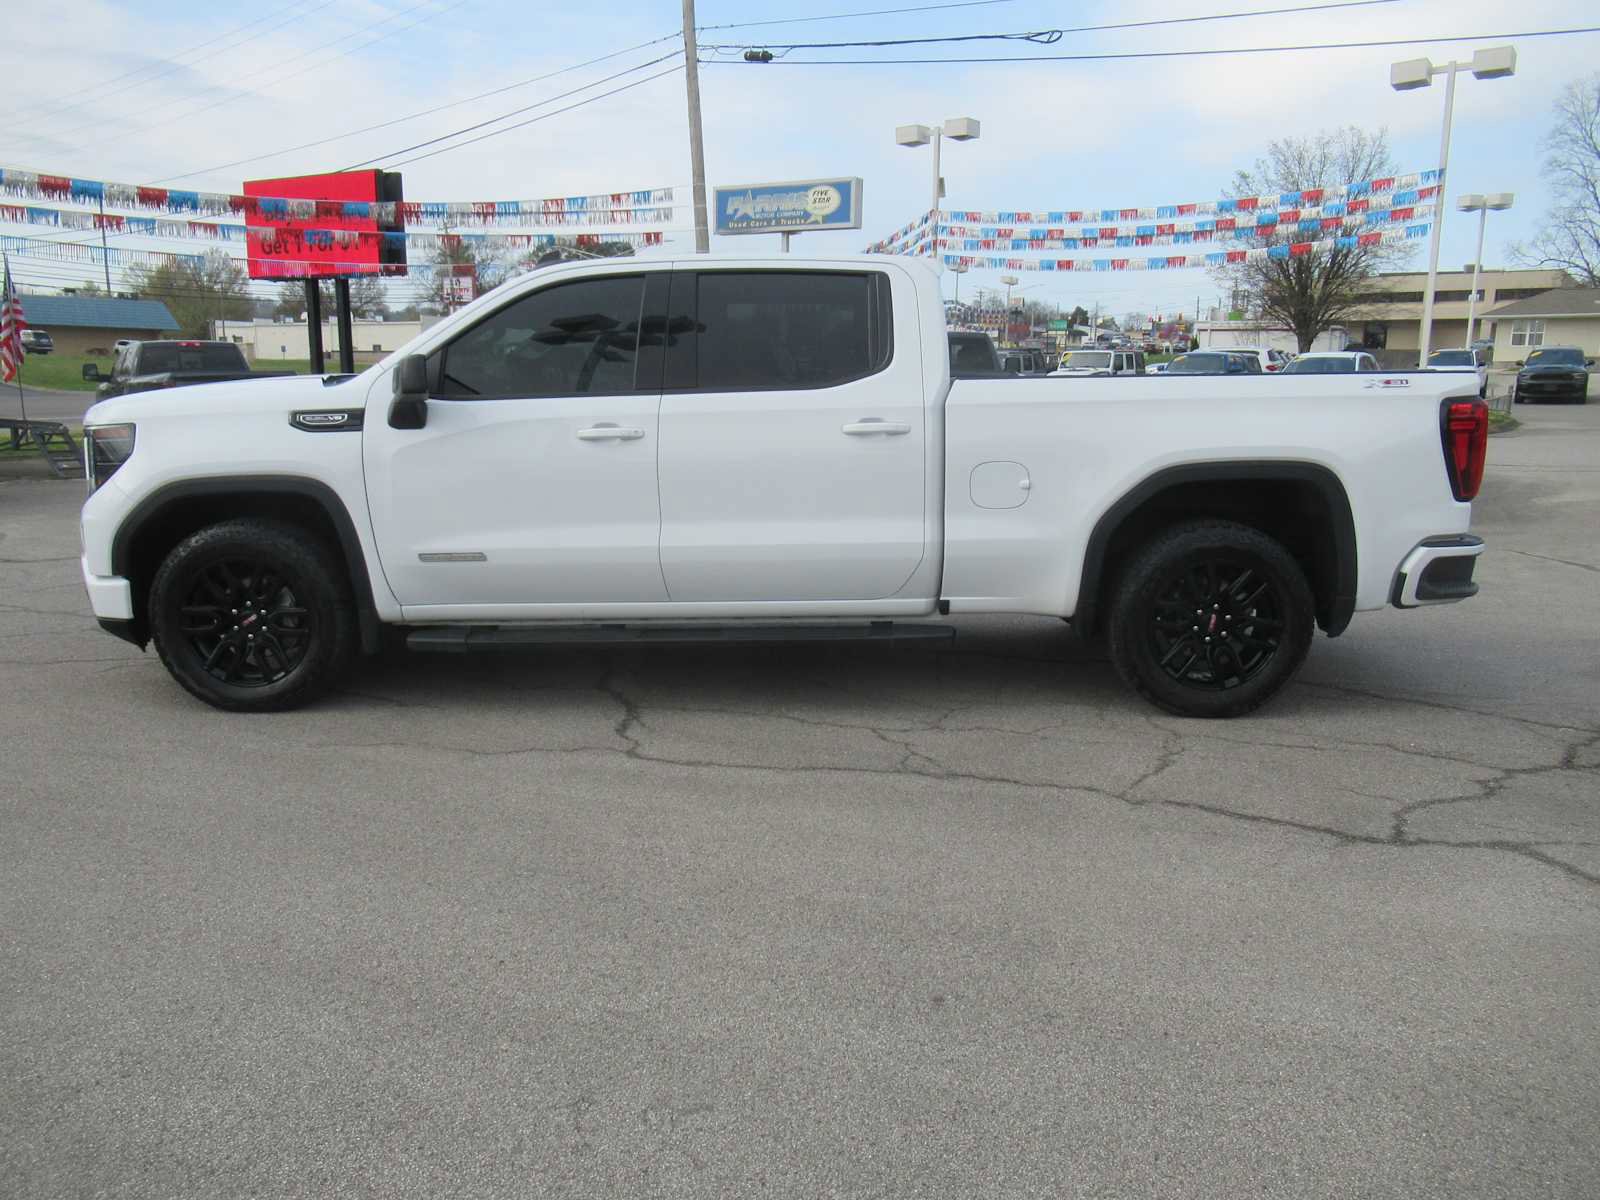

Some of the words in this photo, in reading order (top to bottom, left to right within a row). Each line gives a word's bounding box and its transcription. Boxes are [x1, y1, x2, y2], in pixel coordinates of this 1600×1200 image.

[812, 189, 830, 198] FIVE
[812, 196, 832, 205] STAR
[728, 221, 747, 229] Used
[750, 219, 767, 228] Cars
[780, 218, 805, 226] Trucks
